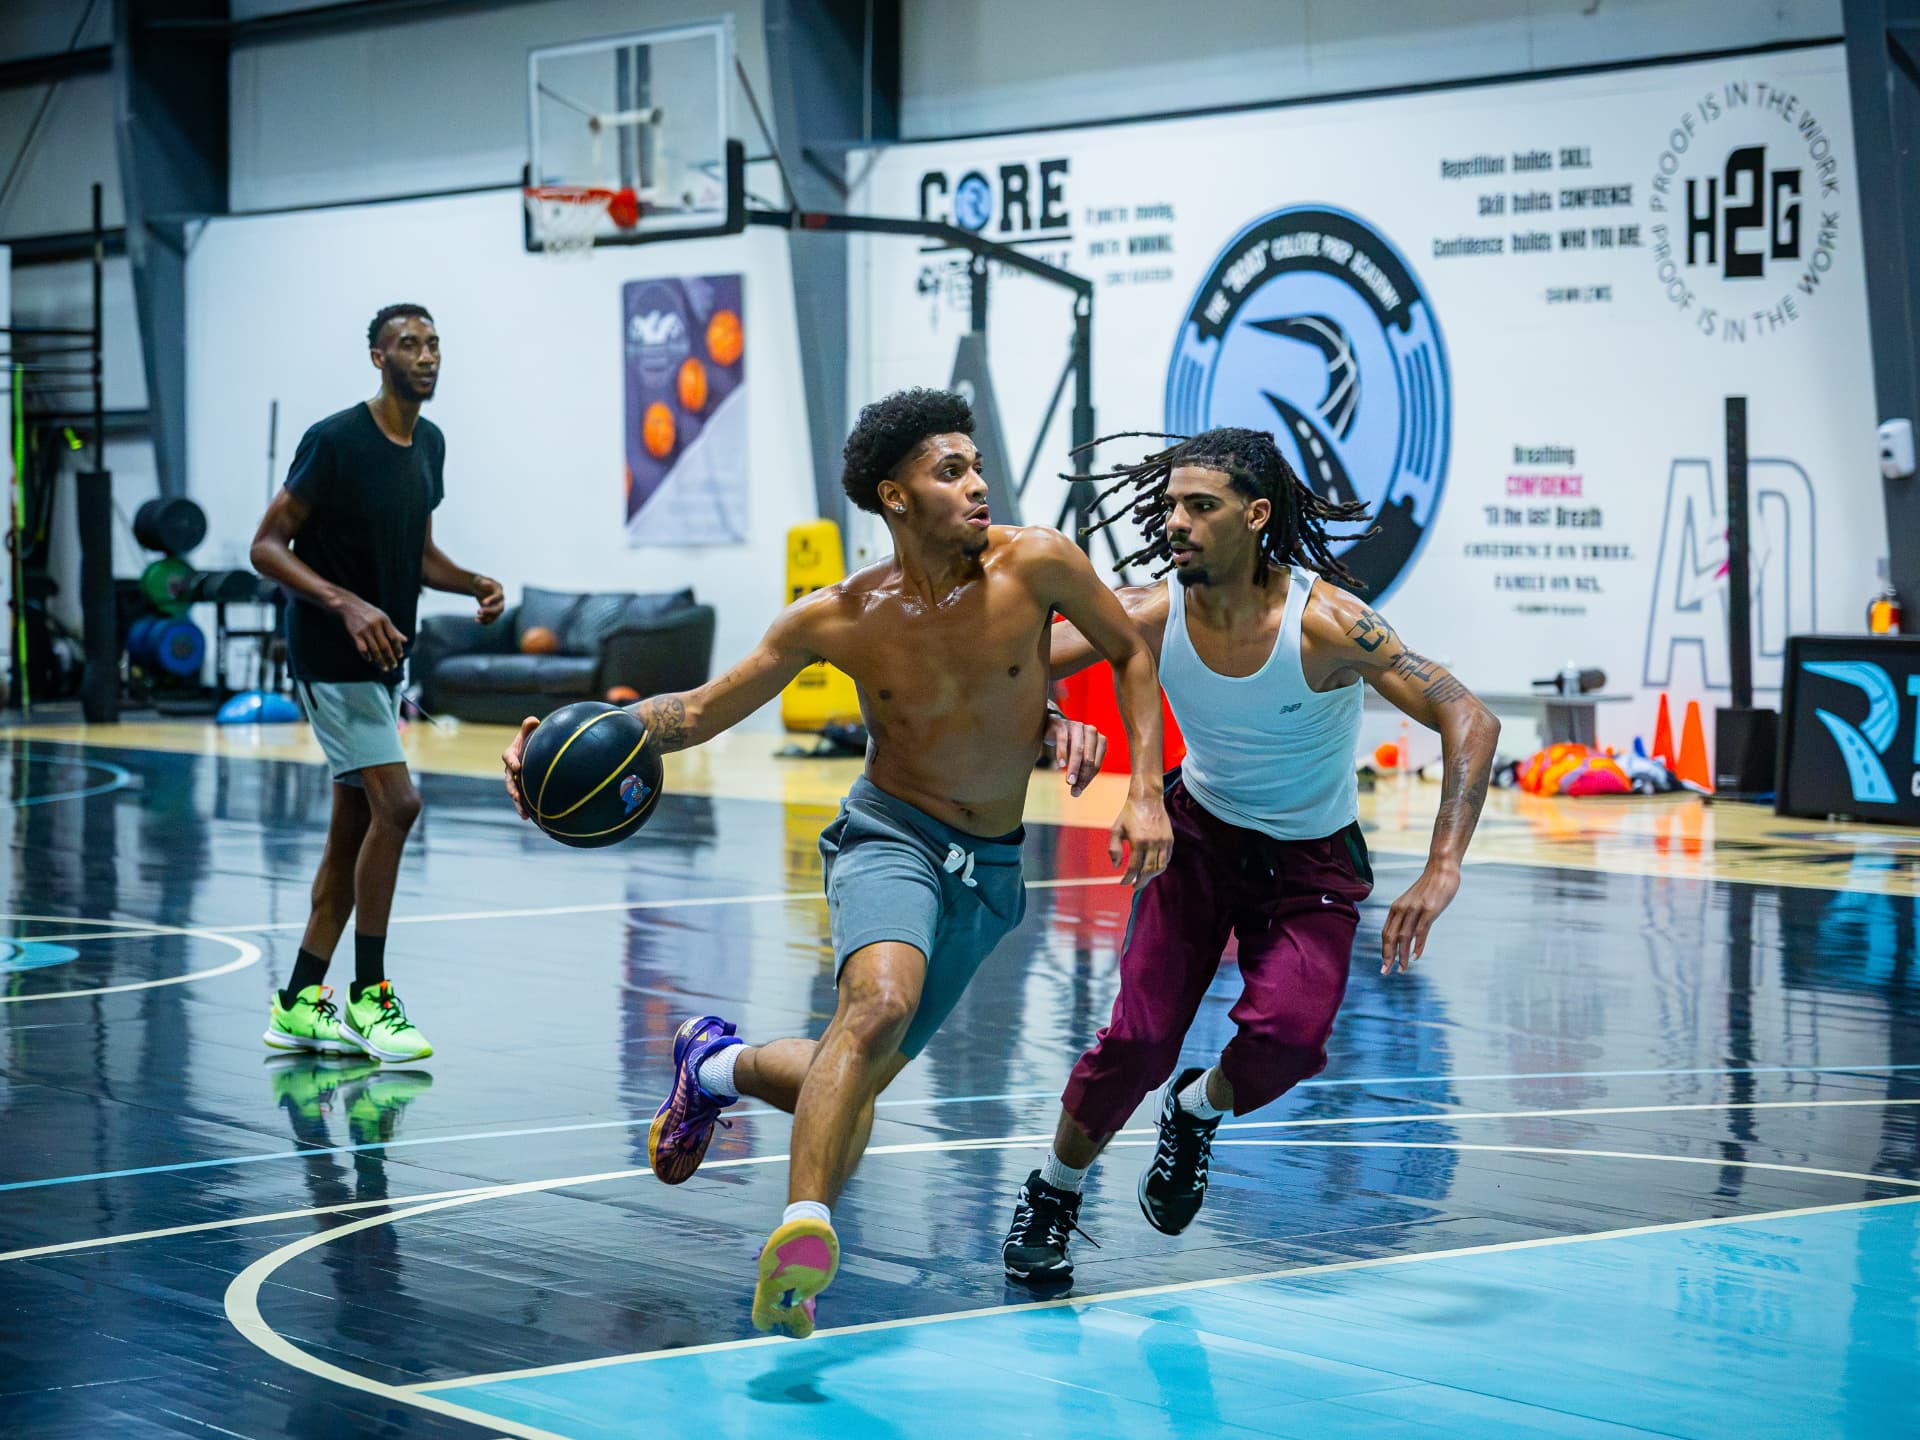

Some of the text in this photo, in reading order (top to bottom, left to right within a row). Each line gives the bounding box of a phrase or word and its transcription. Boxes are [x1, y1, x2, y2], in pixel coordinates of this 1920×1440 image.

[1512, 150, 1552, 172] builds
[1650, 81, 1840, 212] PROOF IS IN THE WORK
[920, 158, 1069, 232] CORE
[1478, 183, 1632, 216] Skill builds CONFIDENCE
[1686, 144, 1802, 278] H2G
[1433, 236, 1504, 259] Confidence
[1512, 232, 1552, 253] builds
[1560, 229, 1586, 249] WHO
[1592, 227, 1613, 248] YOU
[1204, 289, 1230, 325] THE
[1271, 231, 1321, 261] COLLEGE
[1321, 234, 1354, 266] PREP
[1349, 250, 1403, 312] ACADEMY
[1651, 210, 1840, 343] PROOF IS IN THE WORK
[1514, 444, 1575, 468] Breathing
[1506, 474, 1583, 497] CONFIDENCE
